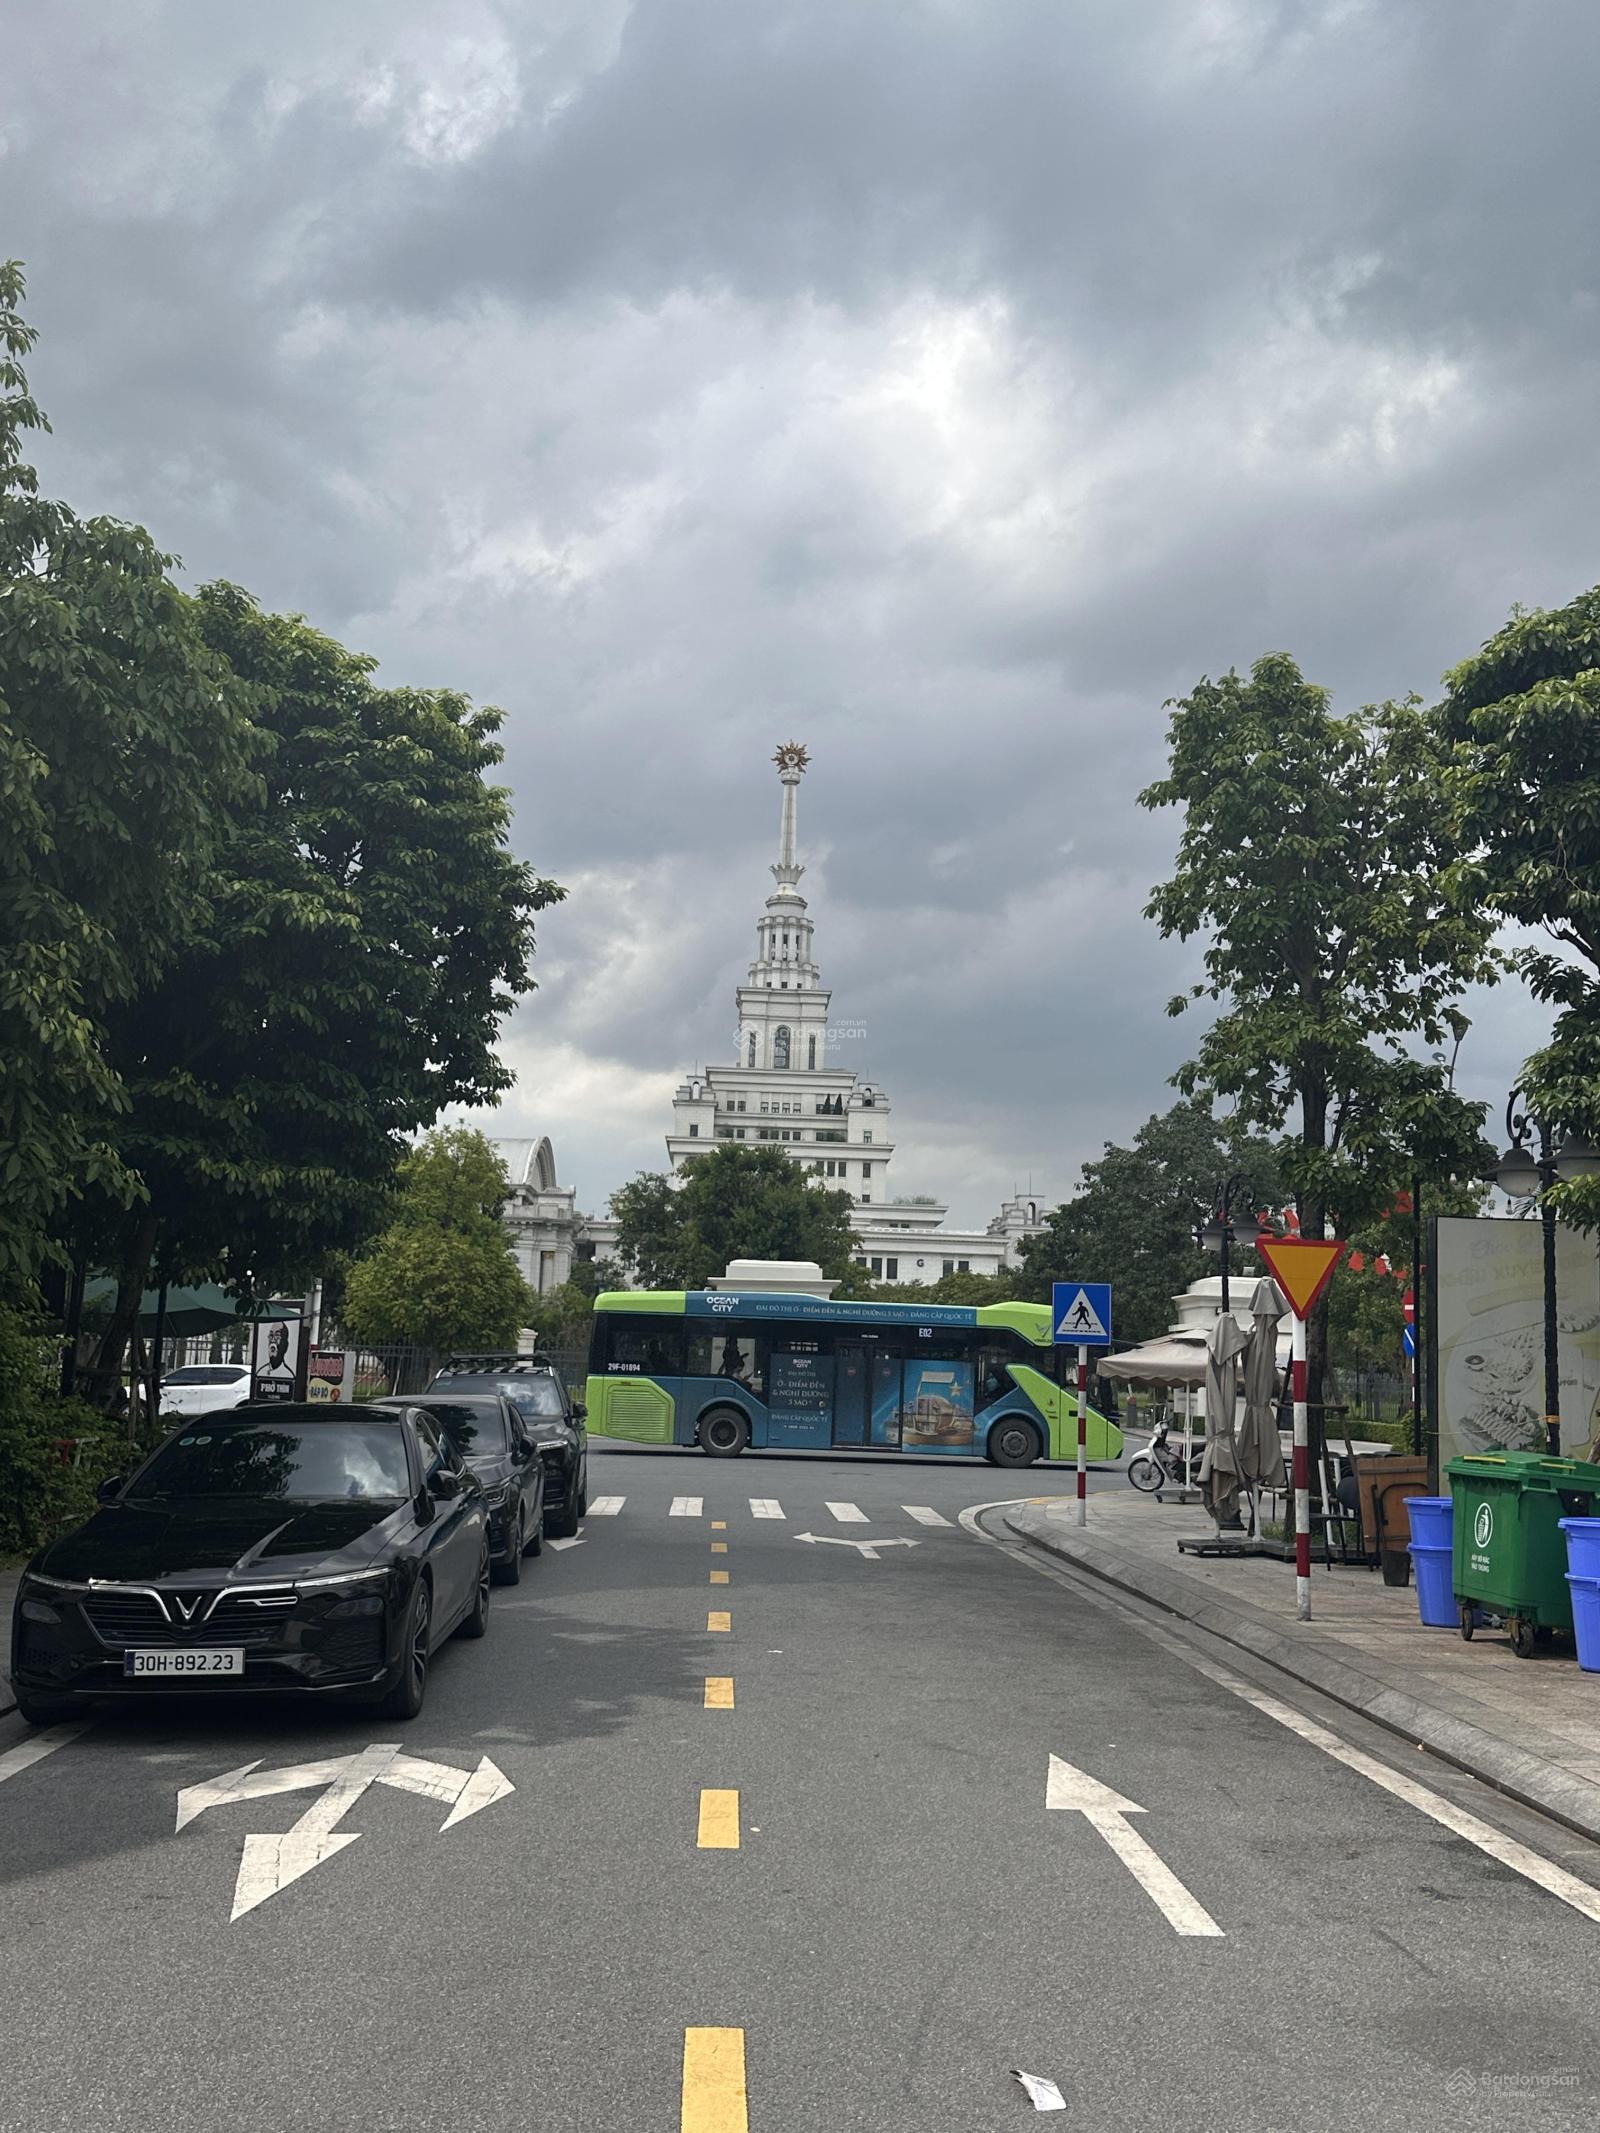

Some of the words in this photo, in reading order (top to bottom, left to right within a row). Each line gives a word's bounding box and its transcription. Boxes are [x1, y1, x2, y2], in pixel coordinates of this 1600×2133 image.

[706, 1296, 739, 1305] OCEAN
[712, 1304, 733, 1313] CITY
[135, 1655, 234, 1671] 30H-892.23
